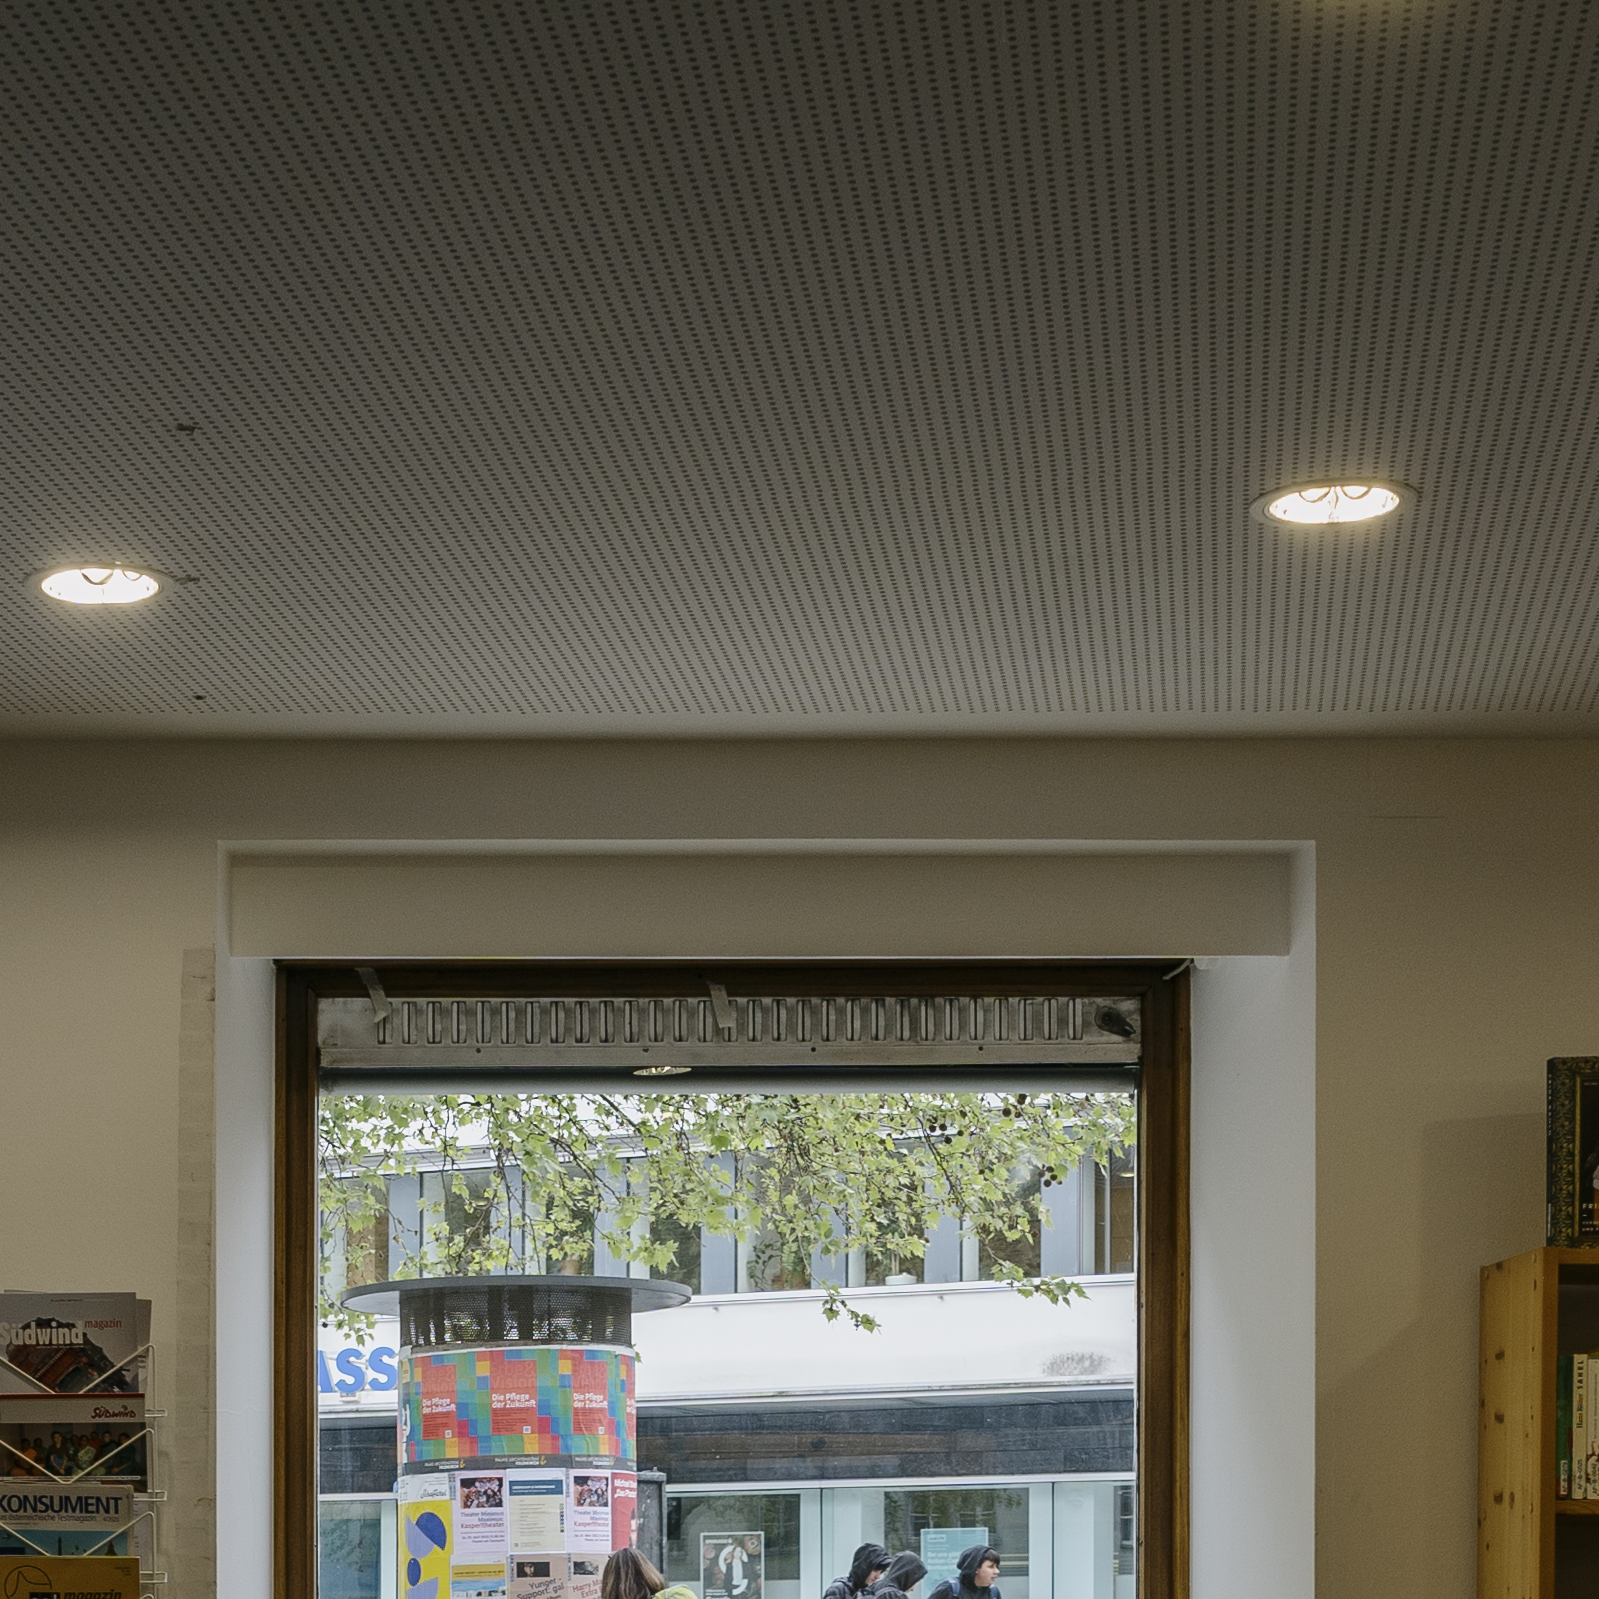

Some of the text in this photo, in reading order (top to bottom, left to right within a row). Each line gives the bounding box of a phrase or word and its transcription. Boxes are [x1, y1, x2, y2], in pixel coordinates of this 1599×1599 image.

[84, 1318, 122, 1330] magazin
[505, 1392, 530, 1400] Pflege
[585, 1393, 604, 1401] Pflege
[423, 1399, 431, 1407] Die
[505, 1400, 536, 1408] Zukunft
[8, 1513, 56, 1521] österreichische
[57, 1514, 97, 1523] Testmagazin
[528, 1578, 557, 1590] Yunger
